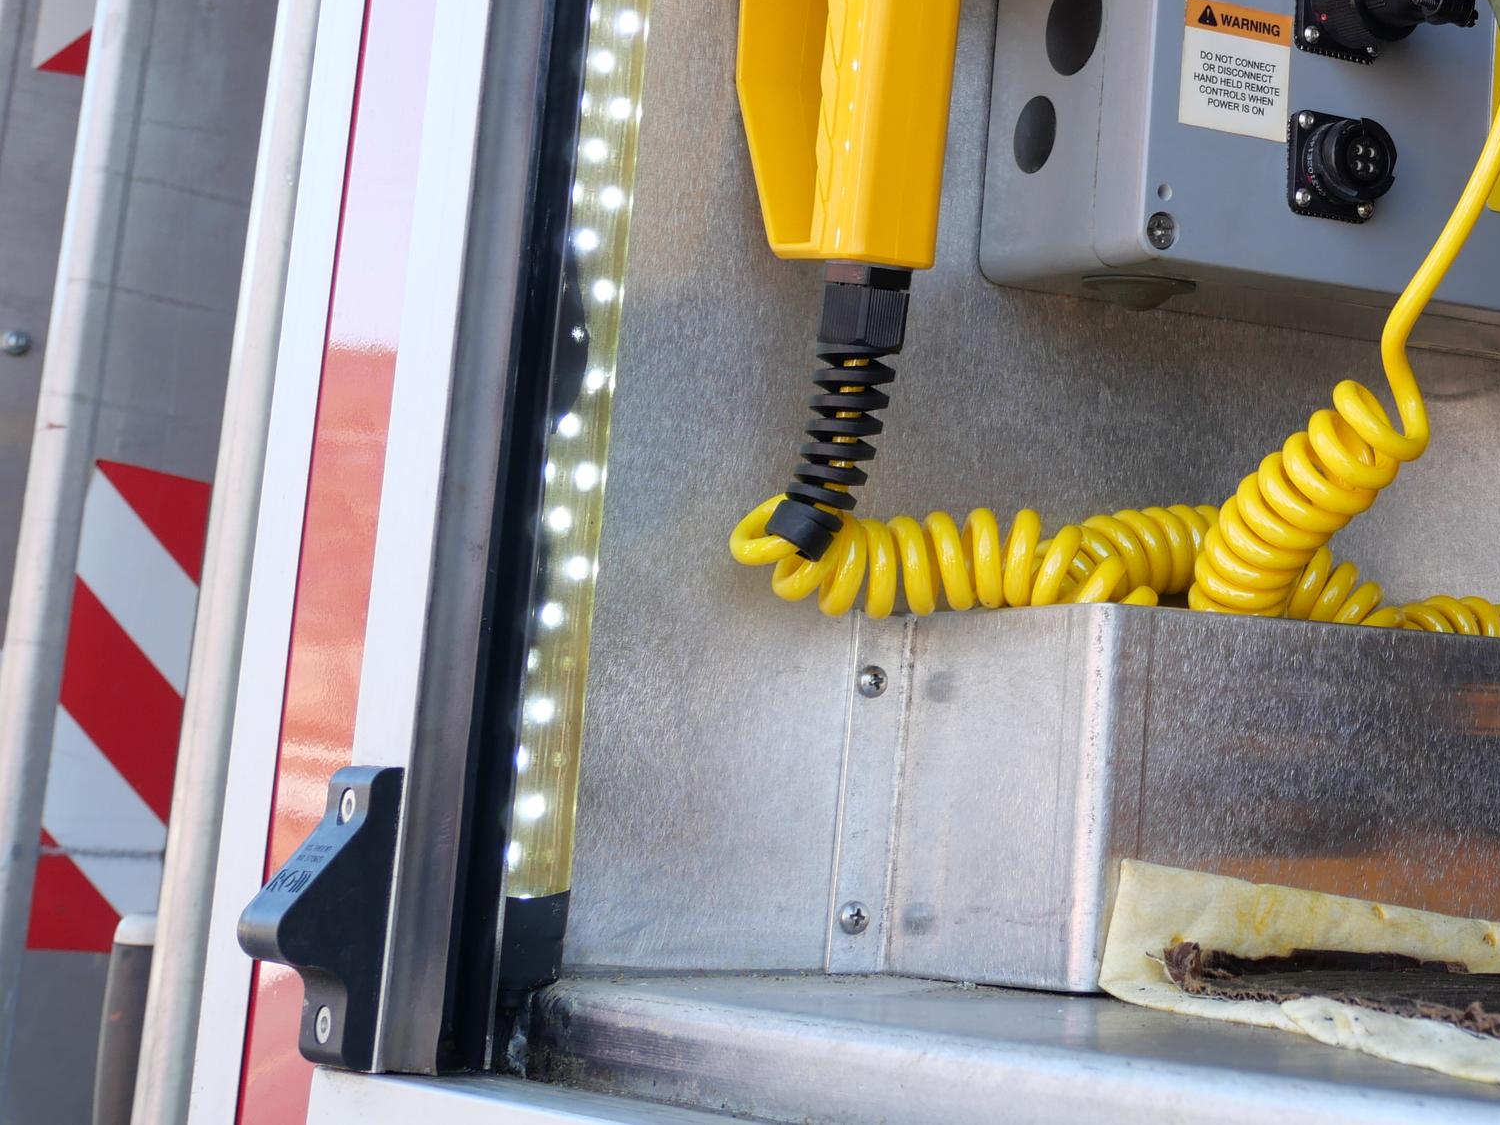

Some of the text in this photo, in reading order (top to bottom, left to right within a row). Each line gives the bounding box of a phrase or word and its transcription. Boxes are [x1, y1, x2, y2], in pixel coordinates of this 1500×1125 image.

[1220, 13, 1281, 37] WARNING
[1200, 50, 1277, 73] DO NOT CONNECT
[1202, 62, 1273, 84] OR DISCONNECT
[1193, 72, 1280, 97] HAND HELD REMOTE
[1199, 85, 1274, 107] CONTROLS WHEN
[1207, 97, 1265, 116] POWER IS ON
